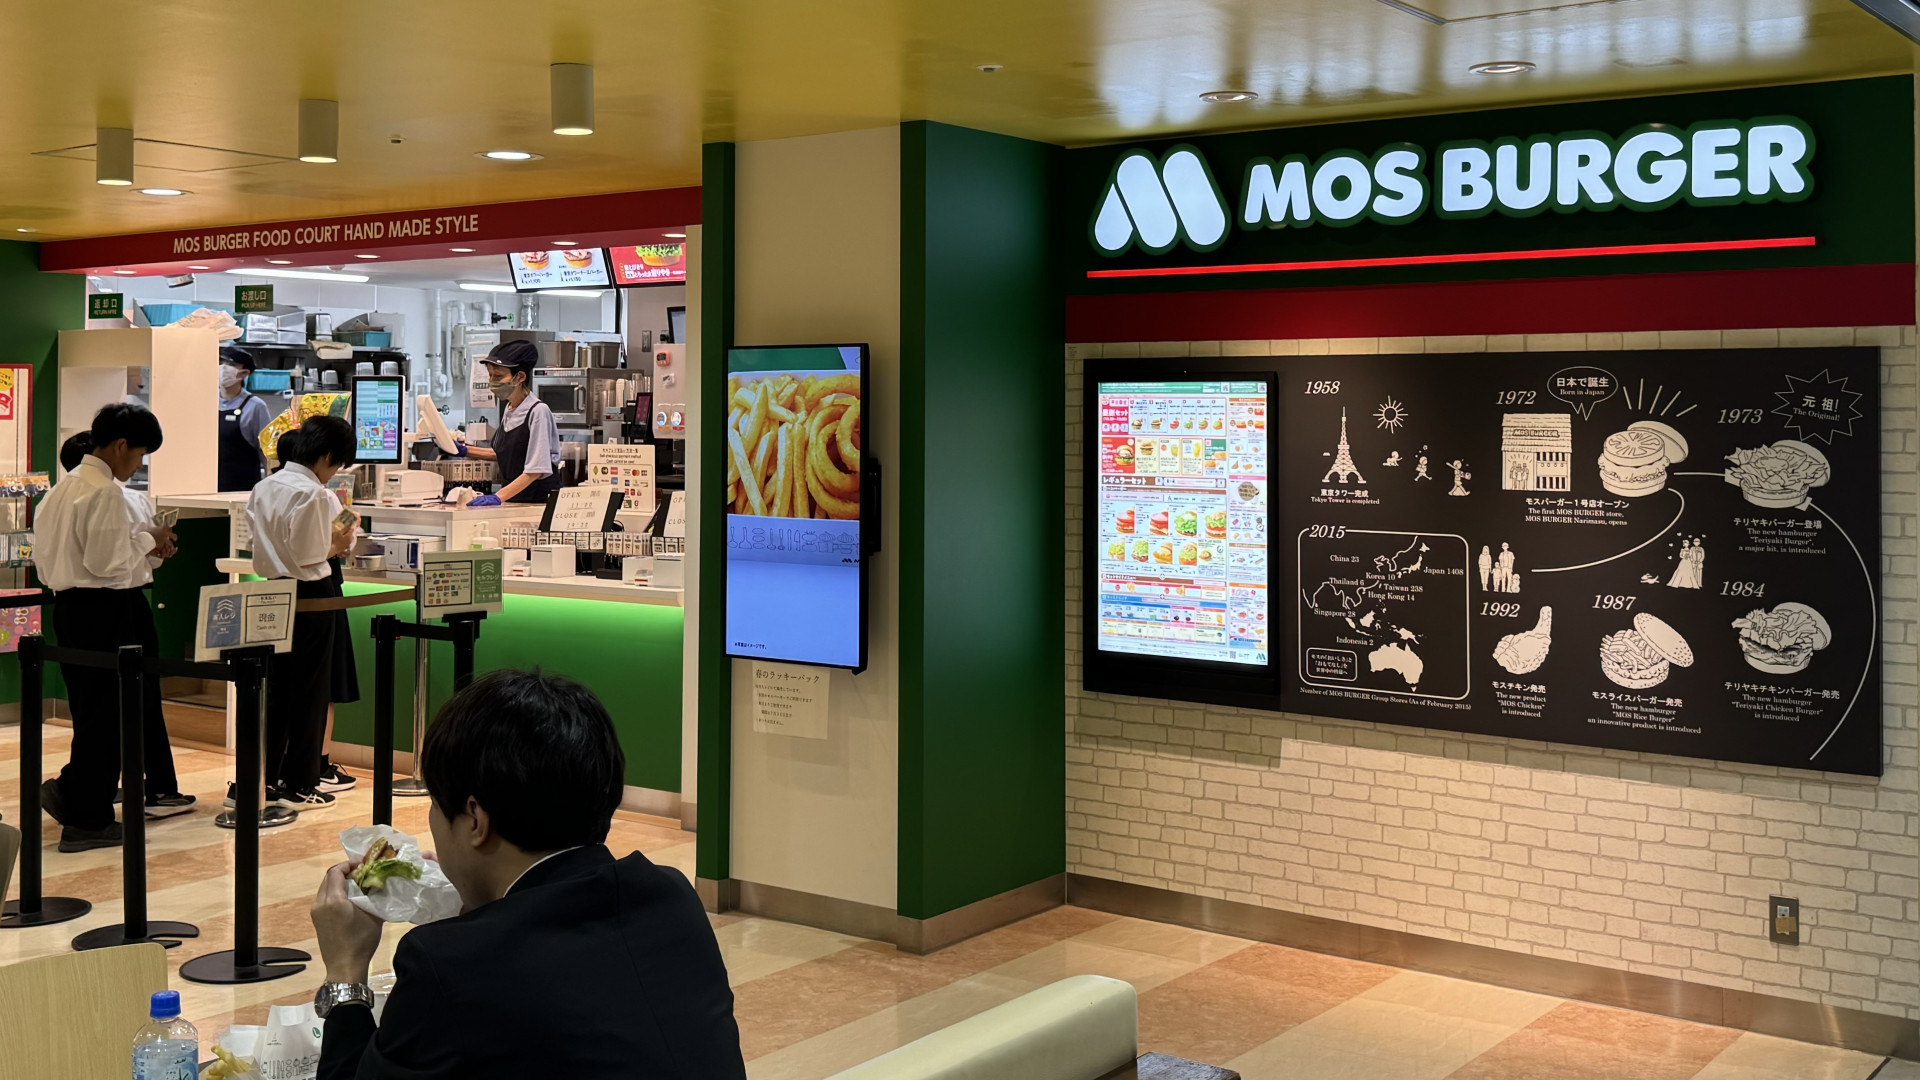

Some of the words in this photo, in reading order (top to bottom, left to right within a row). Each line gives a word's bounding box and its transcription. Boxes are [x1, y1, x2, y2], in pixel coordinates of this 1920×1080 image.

[1244, 150, 1422, 224] MOS
[1441, 124, 1807, 212] BURGER
[173, 236, 200, 254] MOS
[203, 231, 250, 252] BURGER
[253, 229, 291, 248] FOOD
[294, 225, 341, 245] COURT
[344, 221, 384, 241] HAND
[388, 217, 431, 238] MADE
[434, 213, 479, 235] STYLE
[241, 290, 267, 301] お渡し口
[94, 298, 117, 309] 返却口
[1304, 380, 1341, 395] 1958
[1556, 376, 1609, 388] 日本で誕生
[1495, 390, 1537, 405] 1972
[1560, 388, 1575, 396] Born
[1577, 388, 1583, 396] in
[1584, 388, 1605, 397] Japan
[1716, 408, 1763, 424] 1973
[1793, 407, 1807, 416] The
[1808, 409, 1841, 422] Original!
[1320, 488, 1369, 498] 東京タワー完成
[1310, 496, 1327, 505] Tokyo
[1352, 497, 1380, 505] completed
[1528, 507, 1540, 515] The
[1541, 508, 1555, 516] first
[1556, 508, 1573, 516] MOS
[1574, 509, 1605, 517] BURGER
[1525, 515, 1541, 523] MOS
[1542, 515, 1573, 524] BURGER
[1573, 517, 1608, 526] Narimasu,
[1608, 519, 1628, 527] opens
[1733, 517, 1823, 530] テリヤキバーガー登場
[1308, 524, 1346, 539] 2015
[1747, 527, 1761, 535] The
[1778, 529, 1818, 538] hamburger
[1744, 545, 1766, 553] major
[1788, 546, 1826, 555] introduced
[1329, 554, 1350, 563] China
[1351, 555, 1360, 563] 23
[1365, 572, 1386, 581] Korea
[1388, 573, 1396, 581] 10
[1423, 566, 1445, 576] Japan
[1447, 567, 1464, 576] 1408
[1329, 577, 1358, 586] Thailand
[1383, 583, 1409, 592] Taiwan
[1719, 580, 1766, 598] 1984
[1367, 591, 1386, 601] Hong
[1387, 592, 1405, 602] Kong
[1407, 593, 1415, 601] 14
[1592, 594, 1637, 611] 1987
[1313, 607, 1346, 618] Singapore
[1347, 610, 1356, 618] 28
[1479, 602, 1521, 618] 1992
[258, 613, 276, 622] 現金
[1336, 636, 1368, 646] Indonesia
[1491, 681, 1546, 694] モスチキン発売
[1724, 681, 1840, 700] テリヤキチキンバーガー発売
[1299, 687, 1321, 695] Number
[1329, 689, 1343, 697] MOS
[1344, 691, 1370, 700] BURGER
[1371, 693, 1389, 703] Group
[1390, 696, 1408, 704] Stores
[1408, 698, 1418, 706] (As
[1427, 700, 1453, 710] February
[1454, 702, 1471, 711] 2015)
[1495, 691, 1508, 700] The
[1509, 693, 1522, 701] new
[1522, 694, 1547, 703] product
[1592, 691, 1683, 708] モスライスバーガー発売
[1742, 693, 1756, 701] The
[1757, 695, 1771, 703] new
[1773, 696, 1812, 706] hamburger
[1508, 709, 1541, 718] introduced
[1610, 702, 1625, 711] The
[1626, 704, 1639, 712] new
[1640, 704, 1677, 716] hamburger
[1765, 704, 1794, 713] Chicken
[1633, 711, 1648, 720] Rice
[1762, 713, 1800, 722] introduced
[1597, 717, 1631, 728] innovative
[1632, 722, 1657, 731] product
[1658, 723, 1665, 731] is
[1665, 724, 1702, 735] introduced
